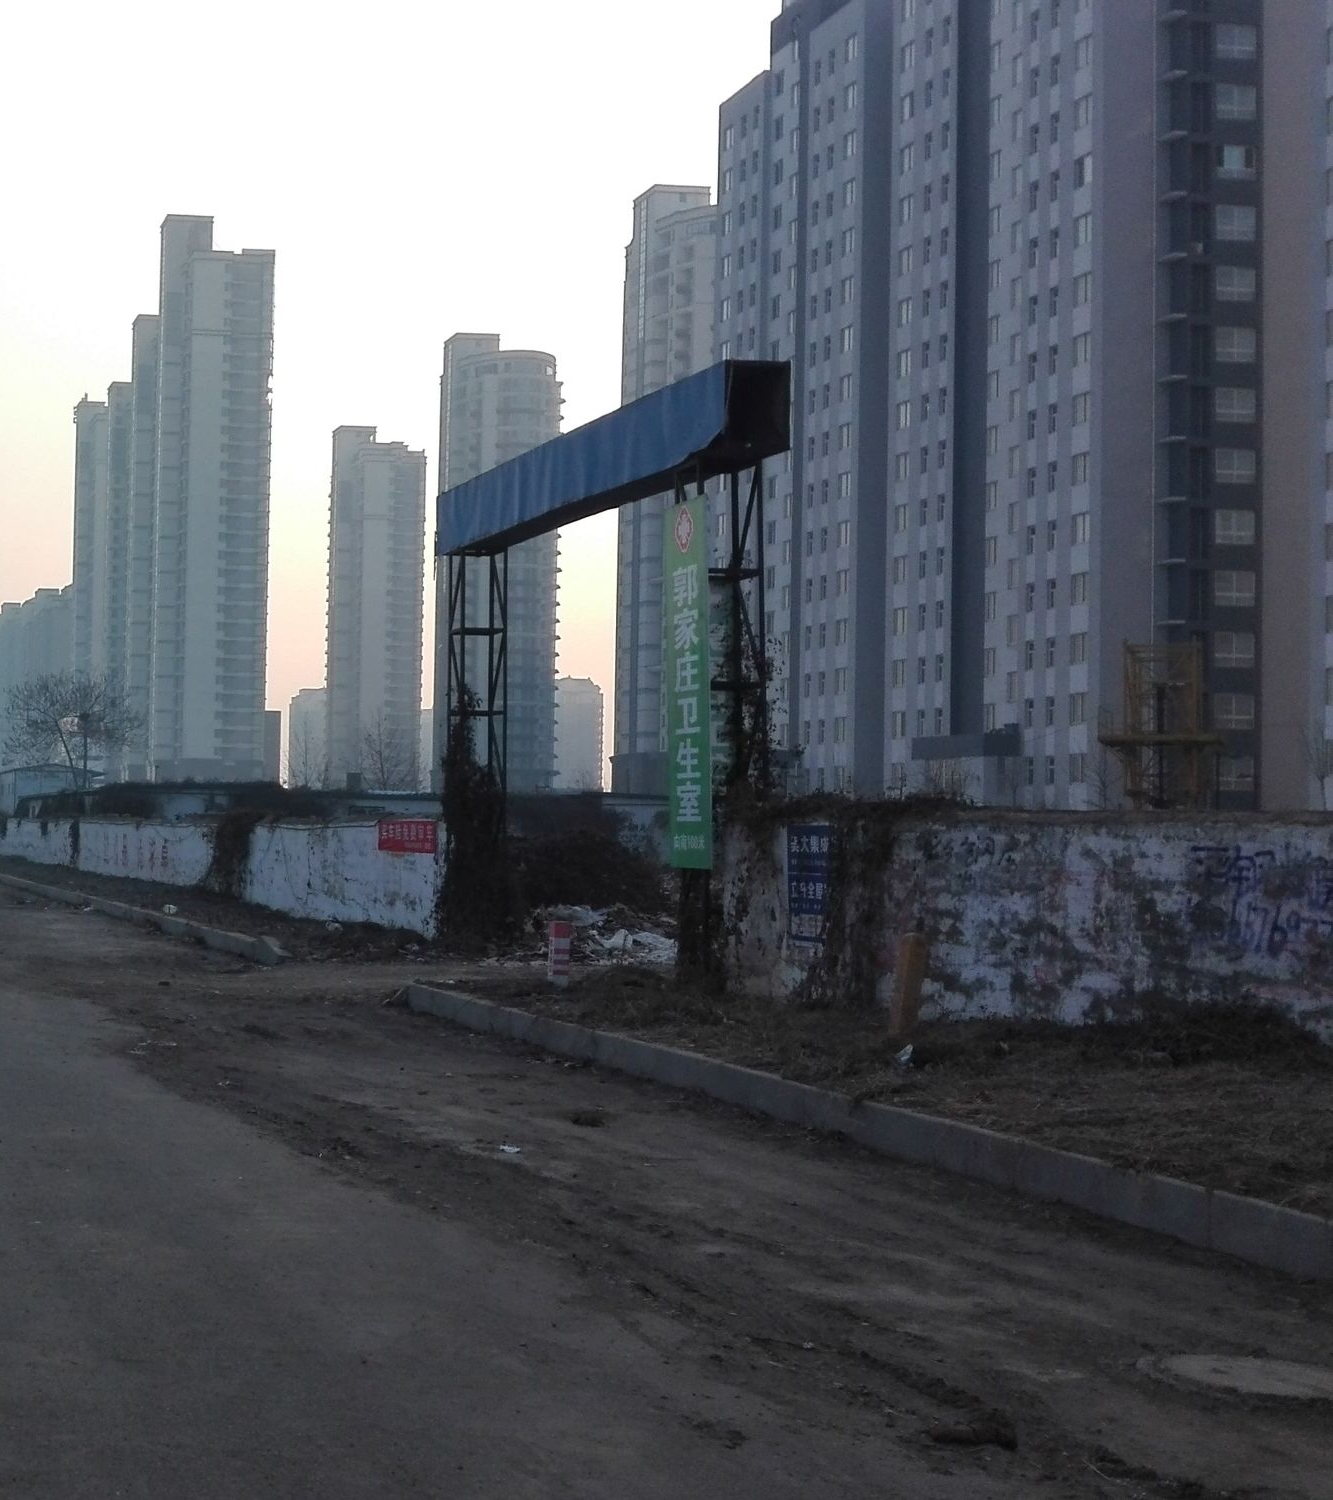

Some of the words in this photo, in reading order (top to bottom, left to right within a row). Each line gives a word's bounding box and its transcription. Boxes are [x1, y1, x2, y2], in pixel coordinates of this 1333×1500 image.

[672, 564, 702, 823] 郭家庄卫生室
